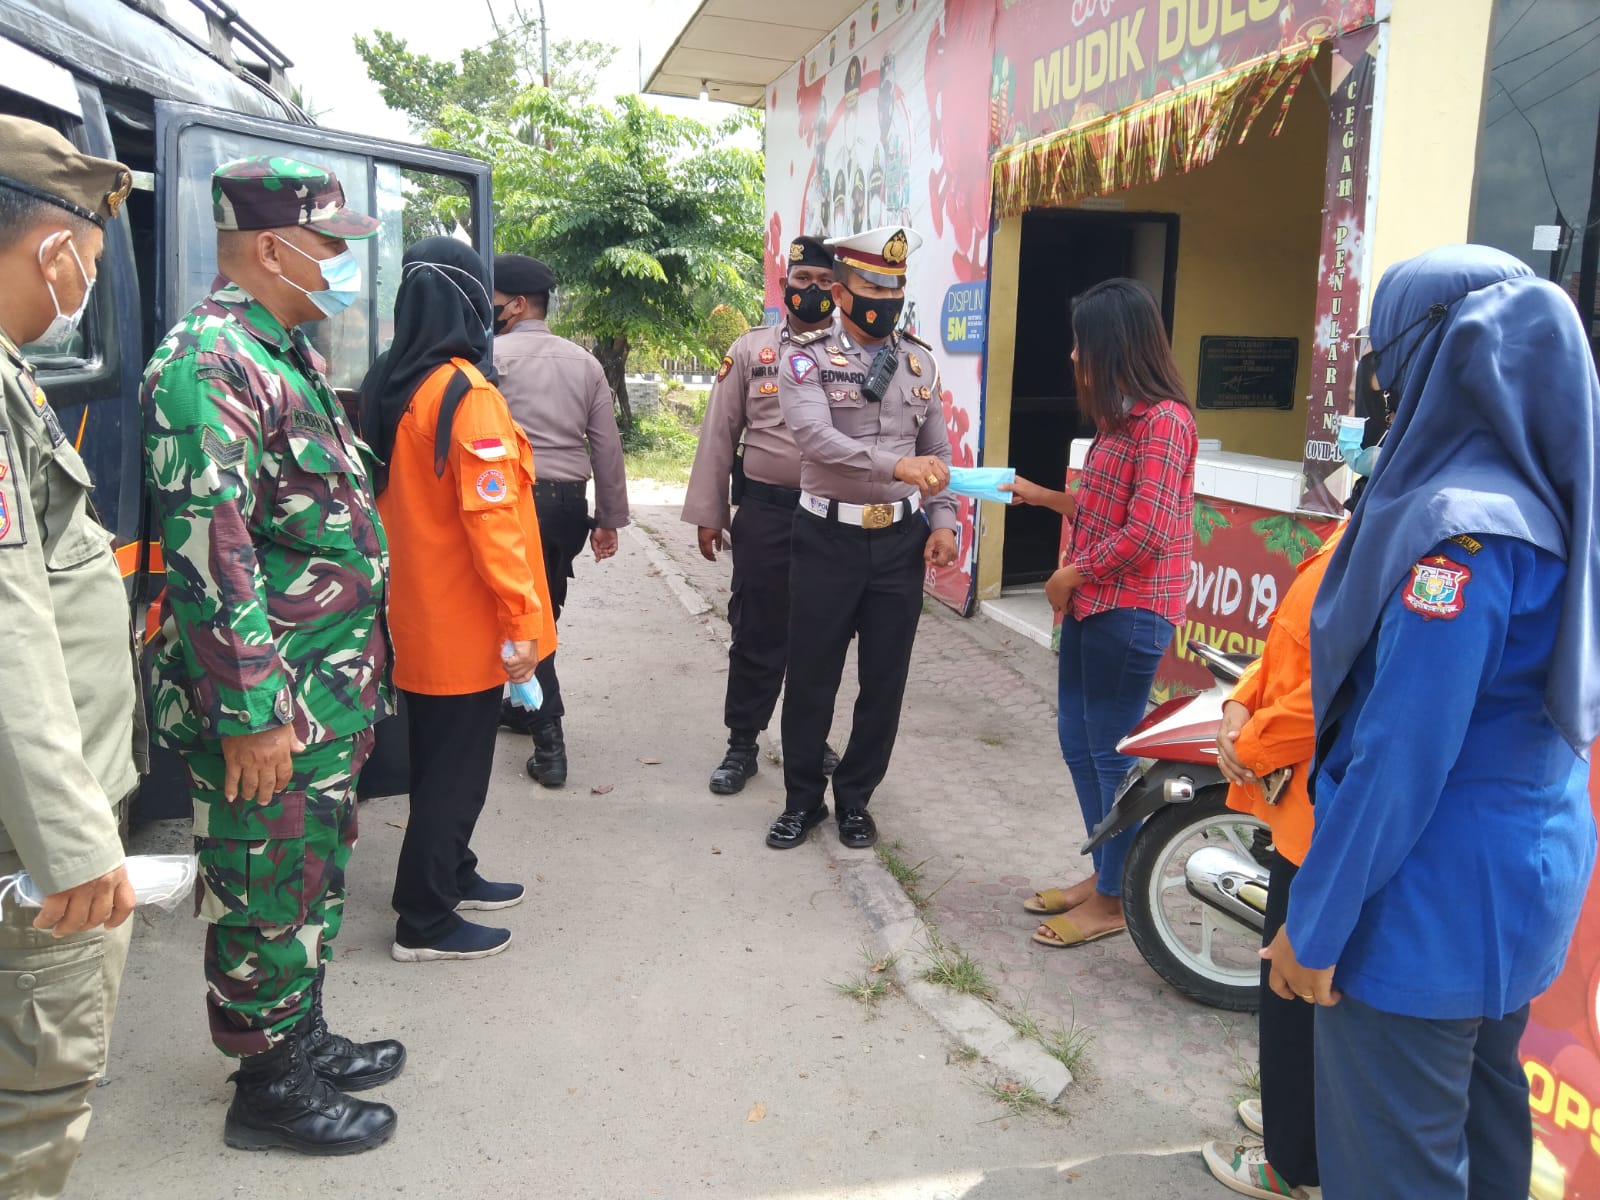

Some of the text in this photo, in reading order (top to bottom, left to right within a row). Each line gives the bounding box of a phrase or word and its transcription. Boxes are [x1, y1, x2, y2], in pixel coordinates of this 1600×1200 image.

[1032, 7, 1145, 113] MUDIK
[1338, 81, 1357, 198] CEGAH
[947, 316, 967, 341] 5M
[1323, 226, 1348, 430] PENULARAN
[821, 369, 866, 385] EDWARD
[1248, 573, 1277, 629] 19
